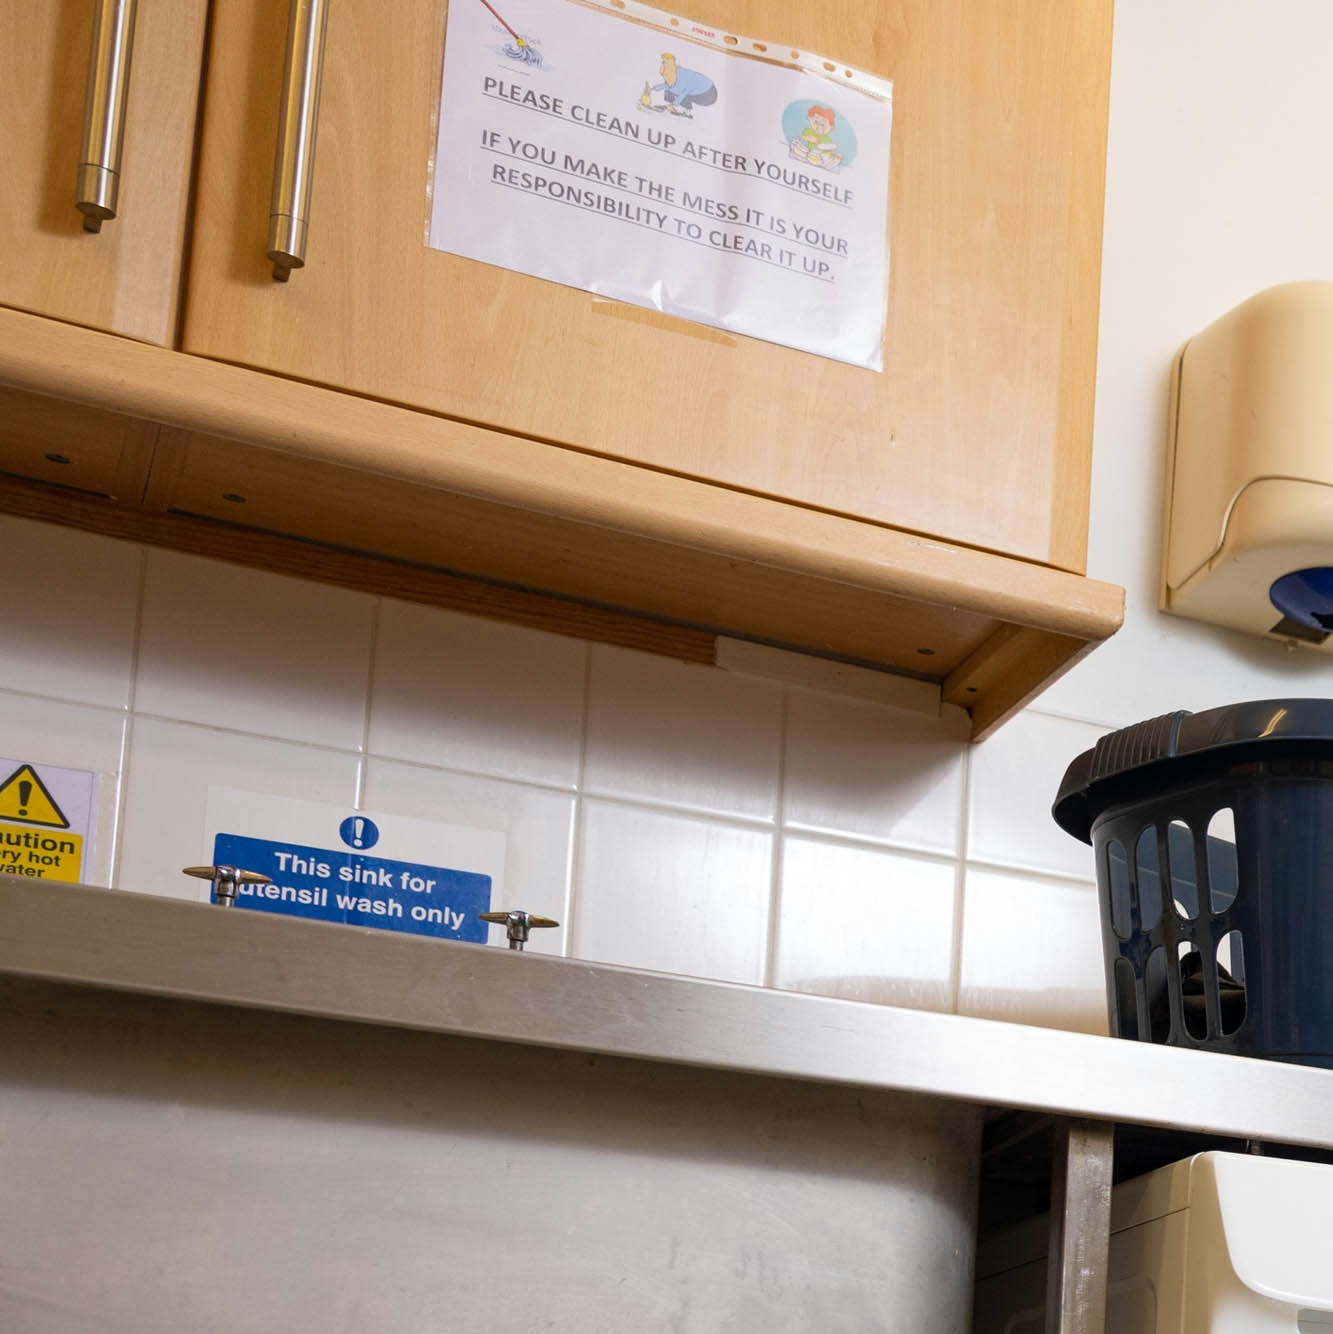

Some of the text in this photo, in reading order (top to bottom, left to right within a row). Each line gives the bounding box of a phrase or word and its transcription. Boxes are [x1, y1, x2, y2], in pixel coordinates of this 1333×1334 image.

[484, 76, 854, 205] PLEASE CLEAN UP AFTER YOURSELF
[482, 129, 849, 255] IF YOU MAKE THE MESS IT IS YOUR
[493, 163, 835, 281] RESPONSIBILITY TO CLEAR IT UP.
[0, 831, 75, 856] ution
[0, 849, 62, 868] ry hot
[274, 851, 437, 894] This sink for
[238, 882, 466, 931] utensil wash only
